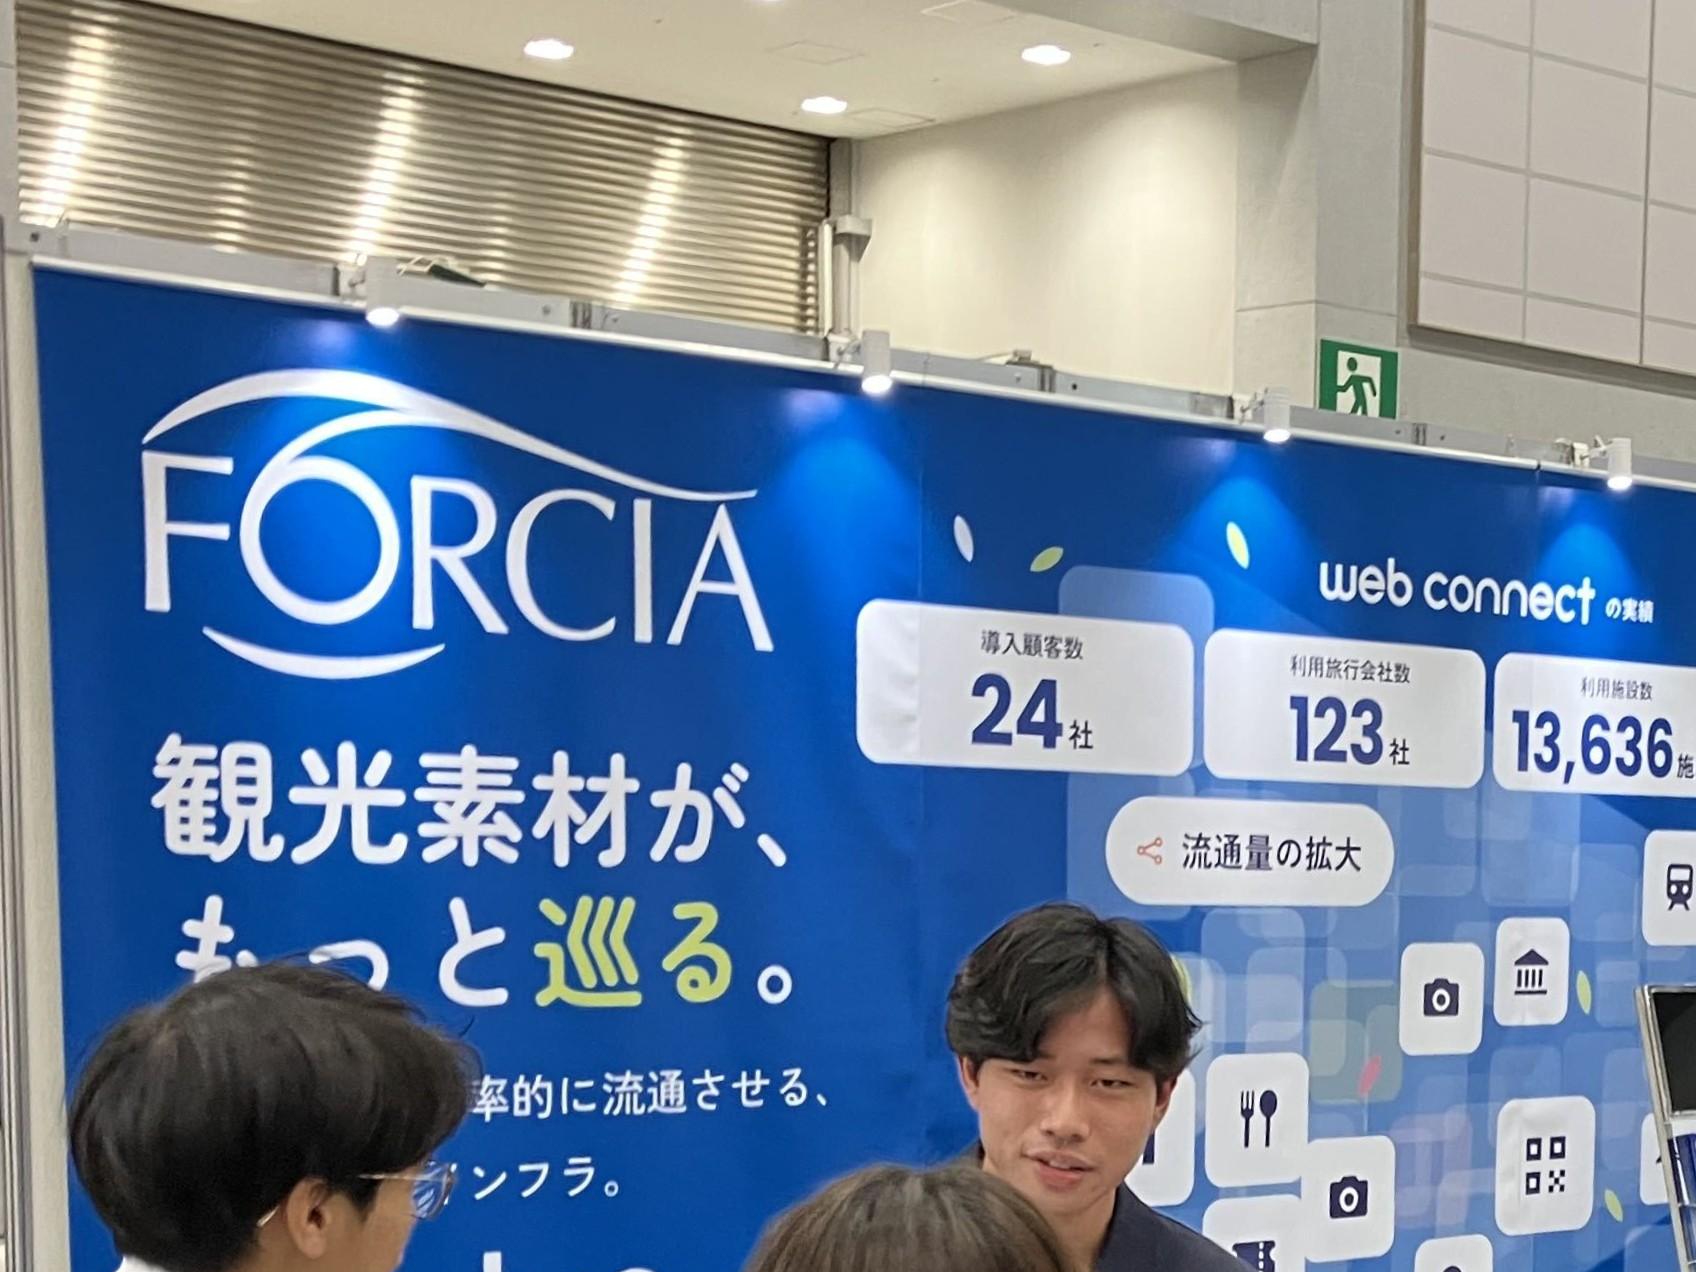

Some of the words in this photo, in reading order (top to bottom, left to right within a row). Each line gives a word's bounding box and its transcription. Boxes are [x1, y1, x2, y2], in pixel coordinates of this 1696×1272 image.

[142, 405, 775, 652] FORCIA
[1319, 557, 1413, 607] web
[1423, 576, 1596, 626] connect
[1605, 596, 1654, 624] の実績
[981, 629, 1083, 660] 導入顧客数
[1290, 654, 1410, 684] 利用旅行会社数
[1581, 676, 1653, 701] 利用施設数
[151, 731, 787, 868] 観光素材が、
[1182, 832, 1362, 872] 流通量の拡大
[445, 1154, 619, 1207] ンフラ。
